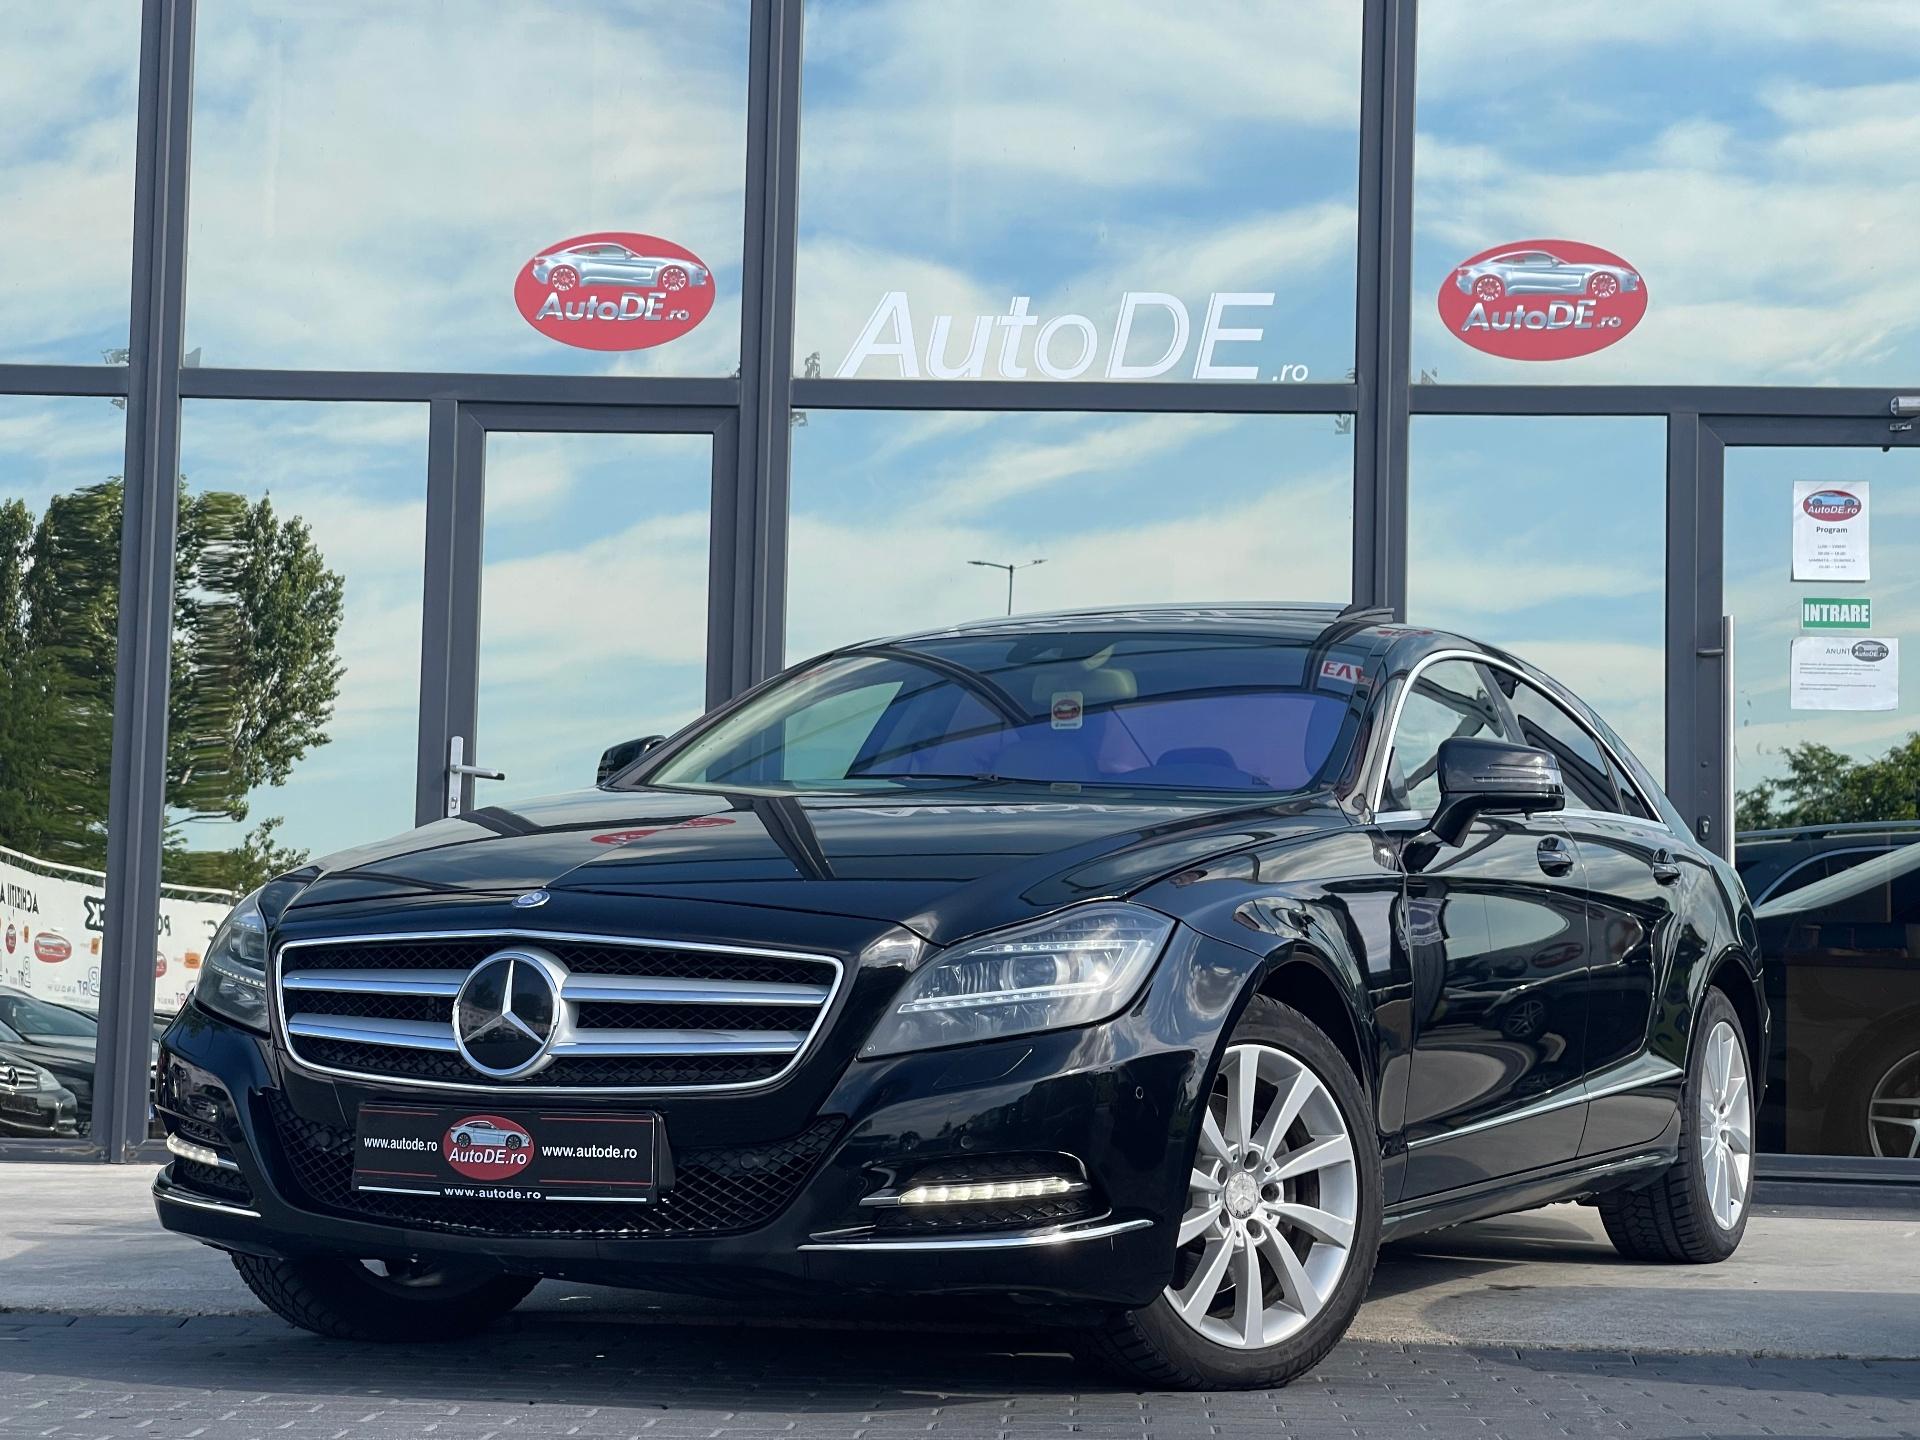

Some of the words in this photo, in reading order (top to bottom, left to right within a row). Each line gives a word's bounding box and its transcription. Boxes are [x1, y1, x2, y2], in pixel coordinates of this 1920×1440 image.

[1816, 526, 1848, 534] Program
[1804, 604, 1869, 622] INTRARE
[364, 1136, 438, 1152] www.autode.ro
[541, 1143, 638, 1159] www.autode.ro
[448, 1148, 527, 1166] AutoDE.ro
[444, 1187, 541, 1200] www.autode.ro
